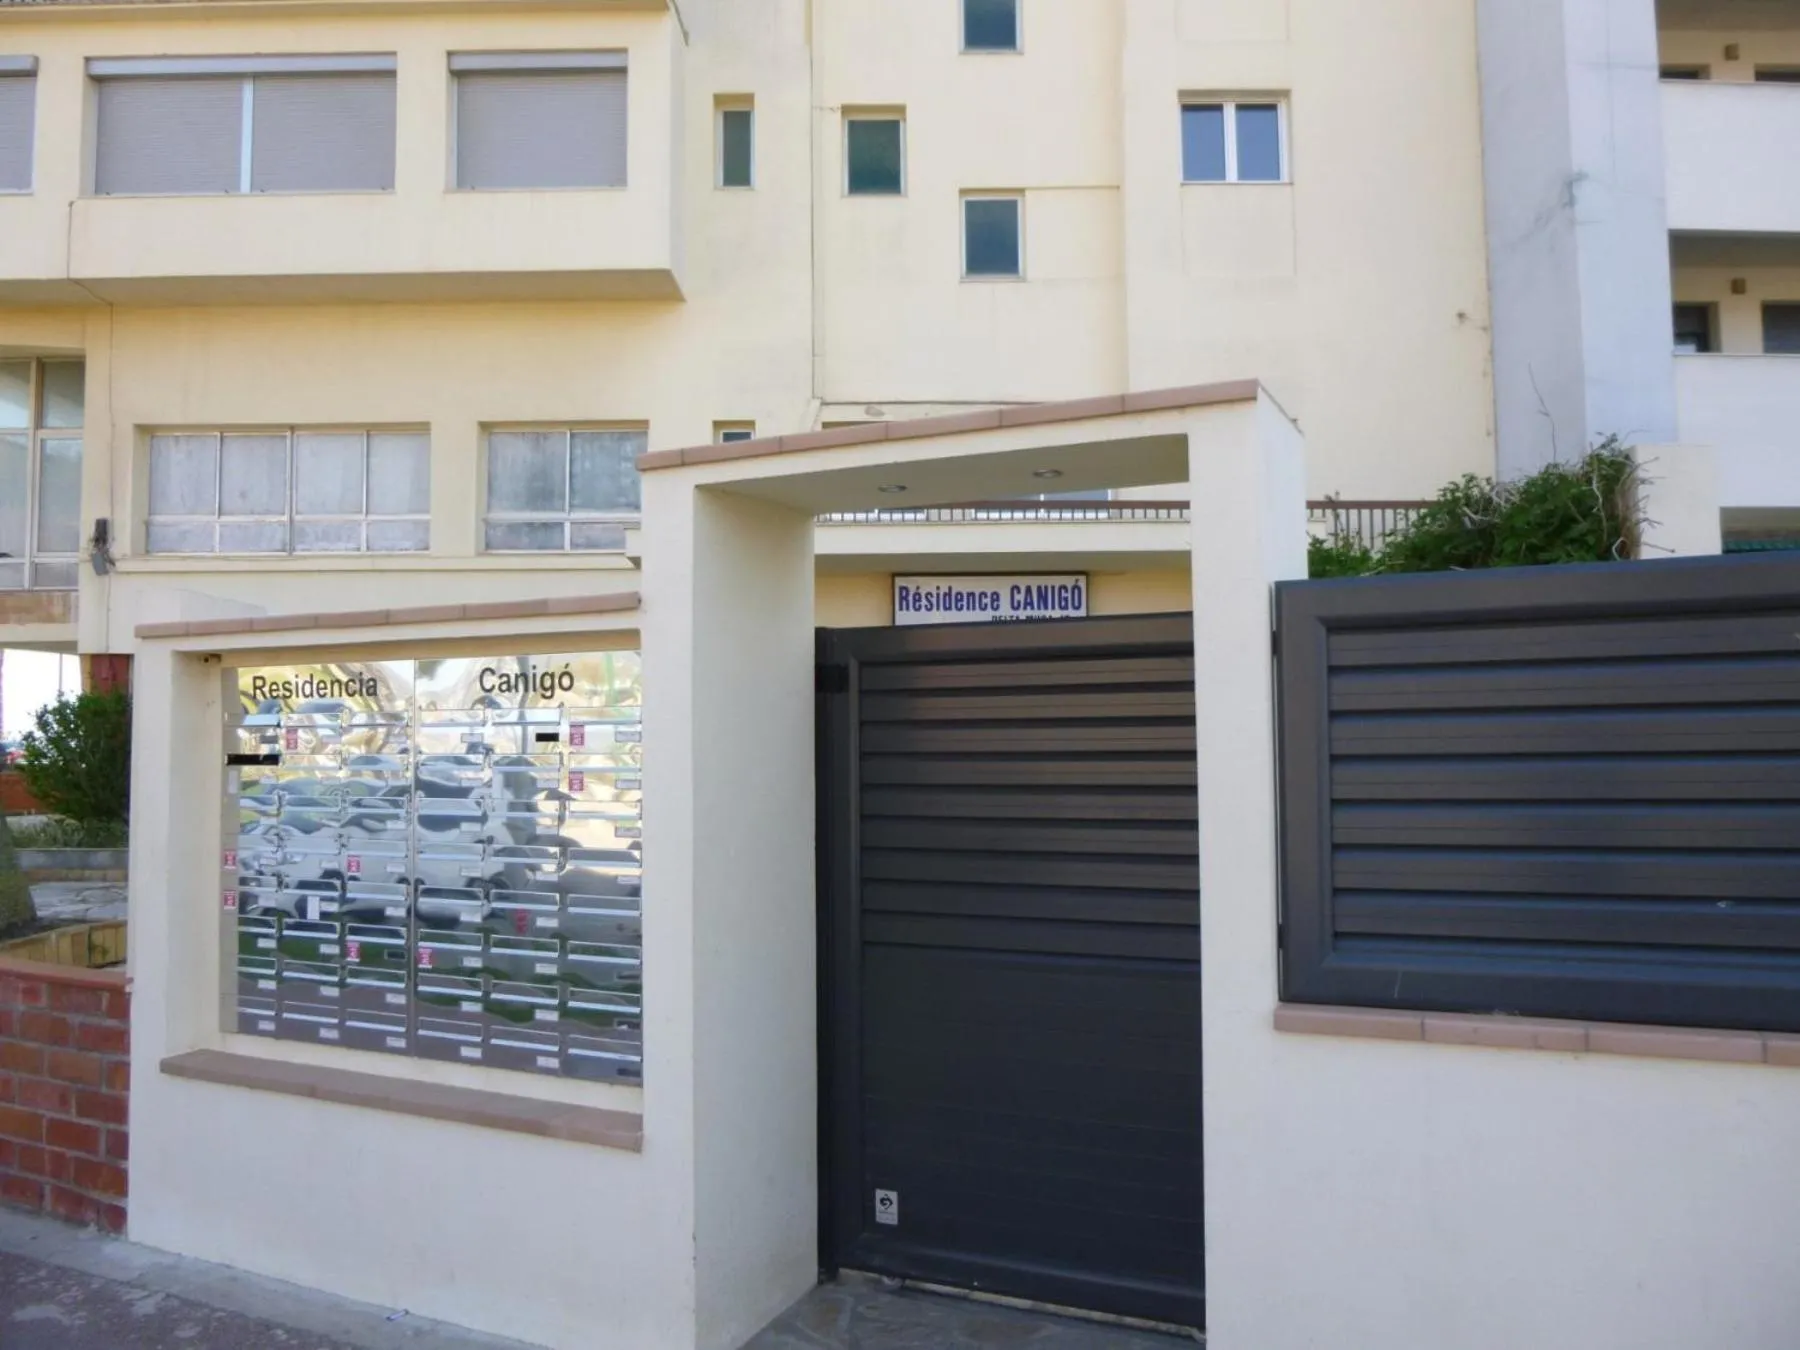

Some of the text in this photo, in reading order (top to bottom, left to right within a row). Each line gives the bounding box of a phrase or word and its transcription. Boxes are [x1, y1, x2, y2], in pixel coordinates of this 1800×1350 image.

[898, 578, 1083, 611] Résidence CANIGÓ
[252, 663, 575, 700] Residencia Canigó
